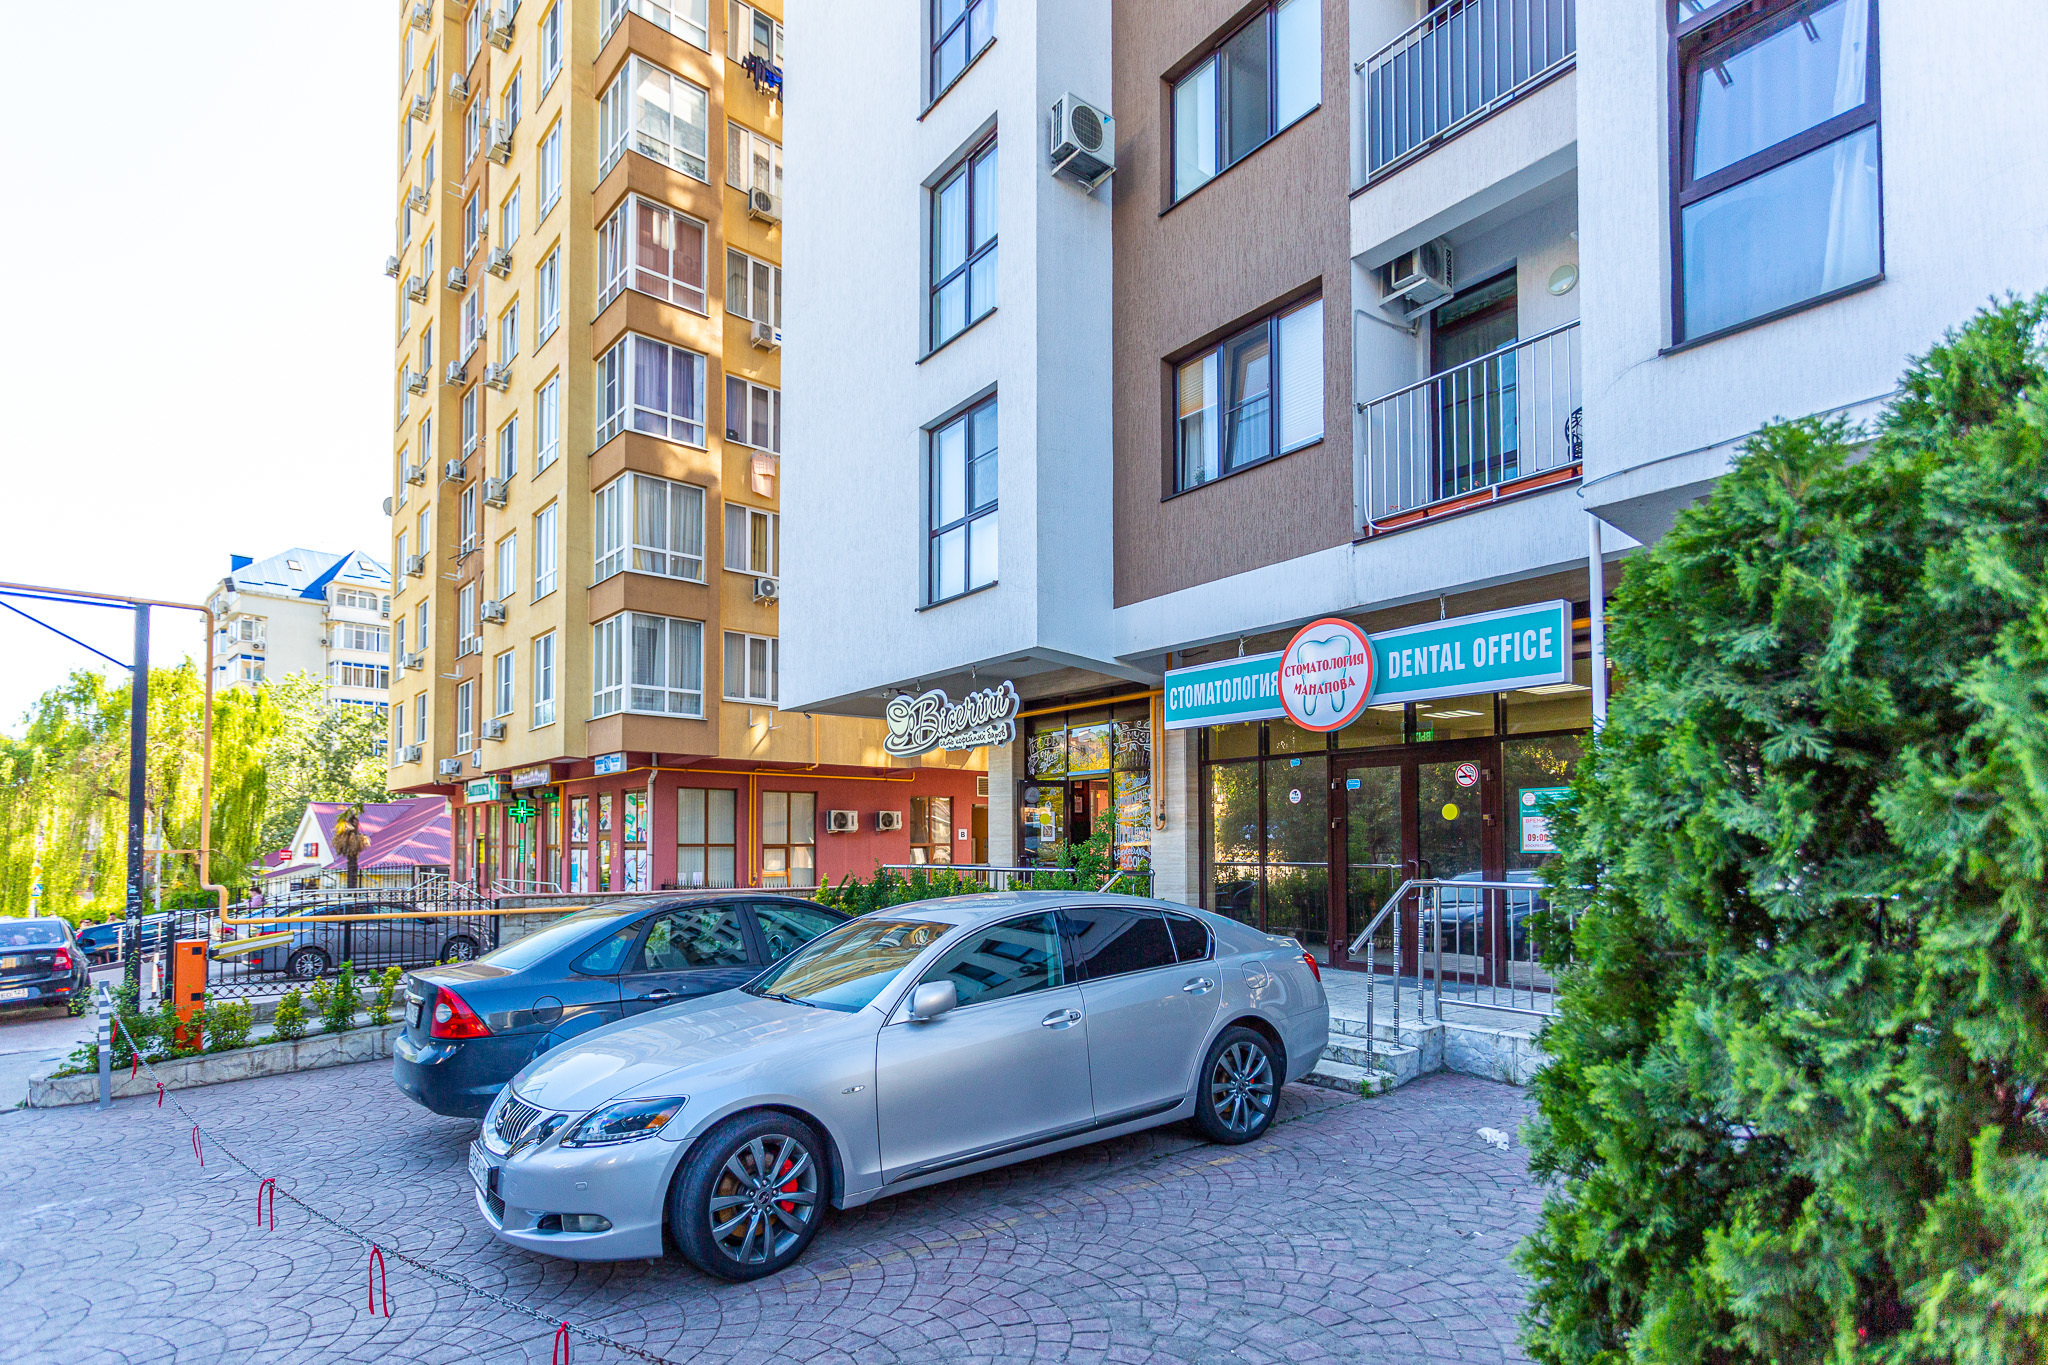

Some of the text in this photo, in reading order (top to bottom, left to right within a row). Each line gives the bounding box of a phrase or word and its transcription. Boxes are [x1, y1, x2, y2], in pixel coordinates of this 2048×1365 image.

[1445, 248, 1453, 289] ZANUSSI
[1284, 652, 1364, 678] СТОМАТОЛОГИЯ
[1388, 626, 1553, 680] DENTAL OFFICE
[1169, 670, 1280, 711] СТОМАТОЛОГИЯ
[1293, 675, 1356, 696] МАНАПОВА
[910, 684, 1010, 748] Bicerini
[986, 724, 1007, 744] баров
